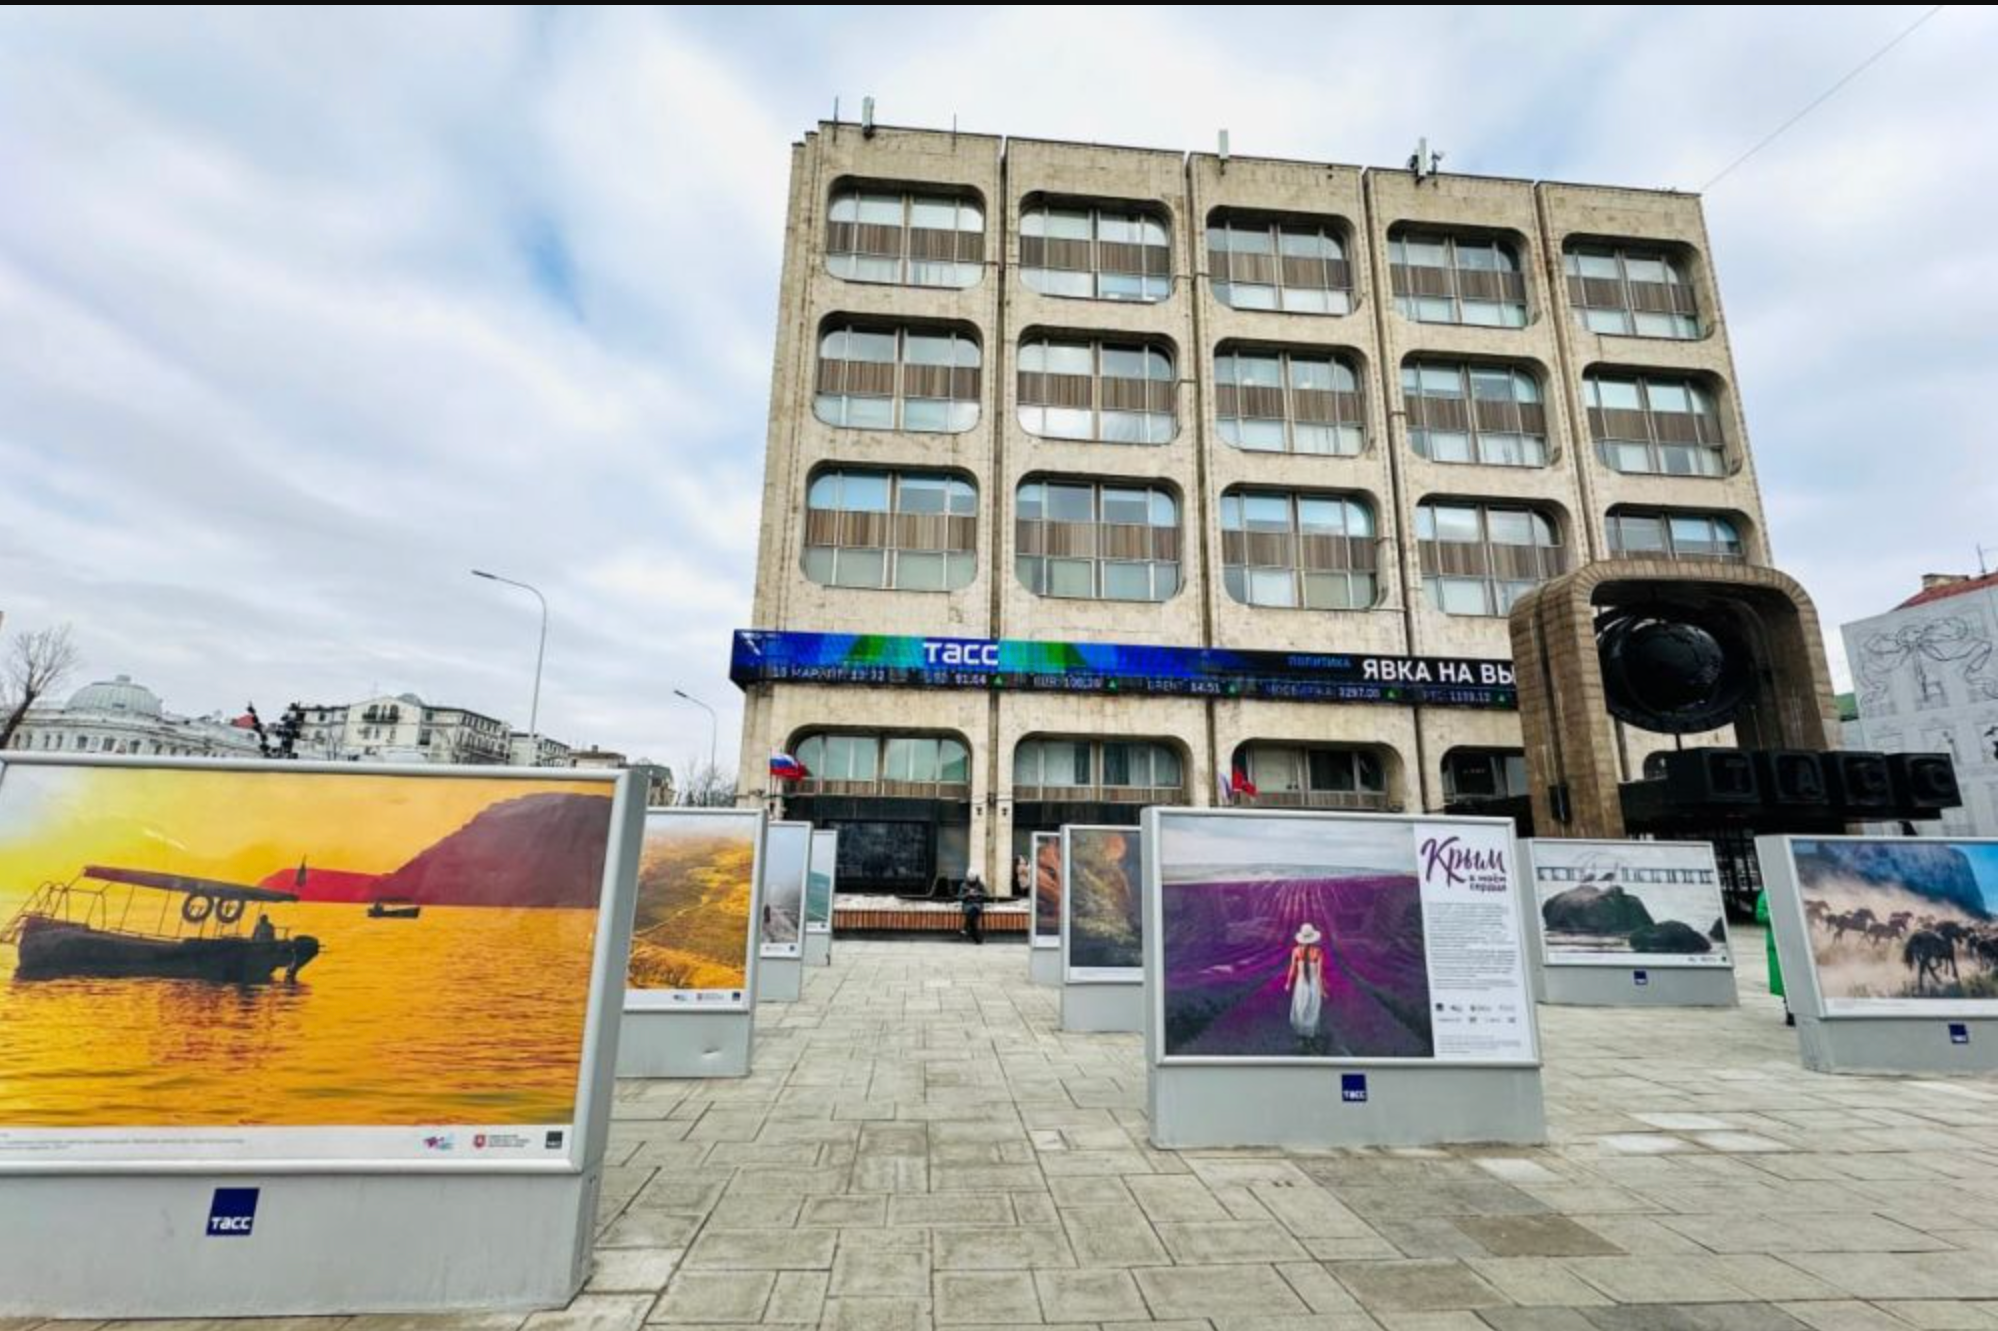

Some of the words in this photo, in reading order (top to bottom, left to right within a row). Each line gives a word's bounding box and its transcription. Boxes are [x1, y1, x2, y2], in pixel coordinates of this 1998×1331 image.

[1362, 658, 1431, 682] ЯВКА
[1438, 661, 1474, 684] НА
[1420, 836, 1506, 888] Крым
